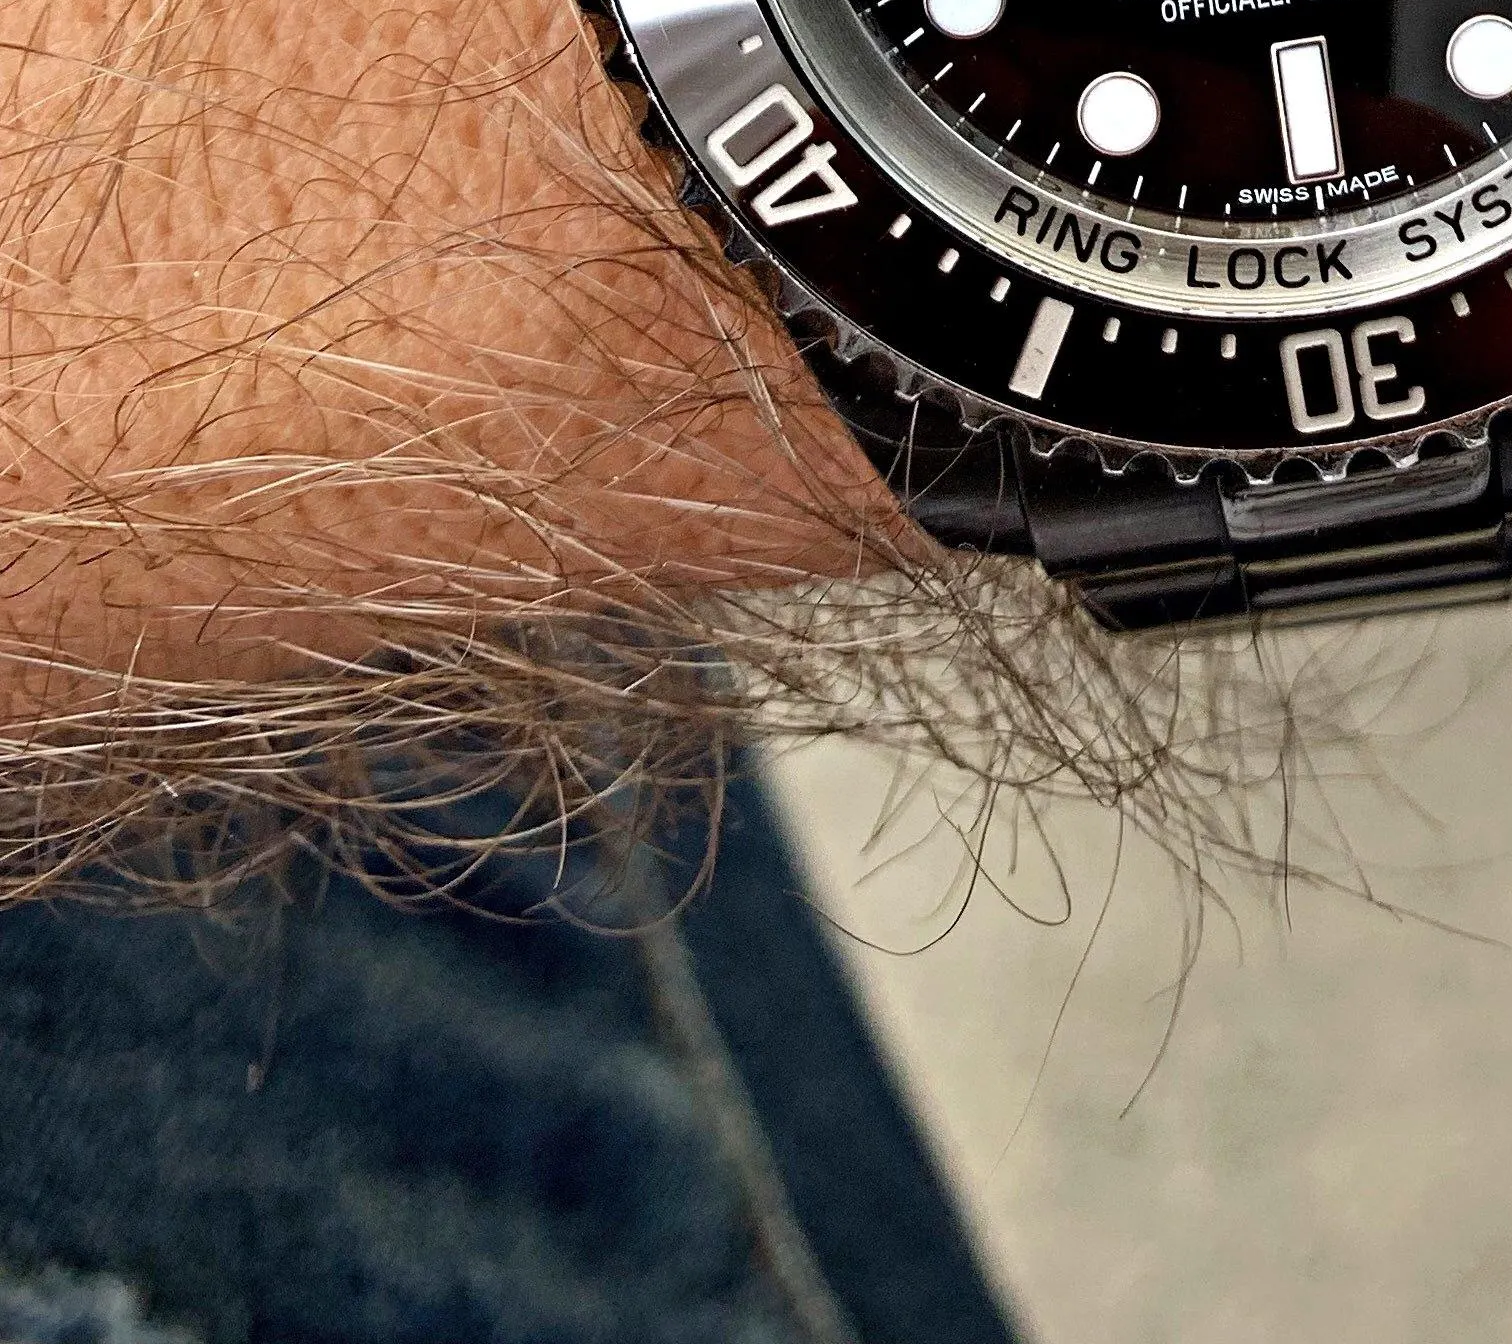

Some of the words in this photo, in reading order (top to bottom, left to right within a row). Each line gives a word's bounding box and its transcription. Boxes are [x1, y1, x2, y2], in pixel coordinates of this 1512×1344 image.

[707, 84, 858, 226] 40
[1238, 186, 1310, 204] SWISS
[1327, 165, 1400, 197] MADE
[994, 185, 1140, 270] RING
[1185, 238, 1354, 290] LOCK
[1282, 315, 1425, 434] 30
